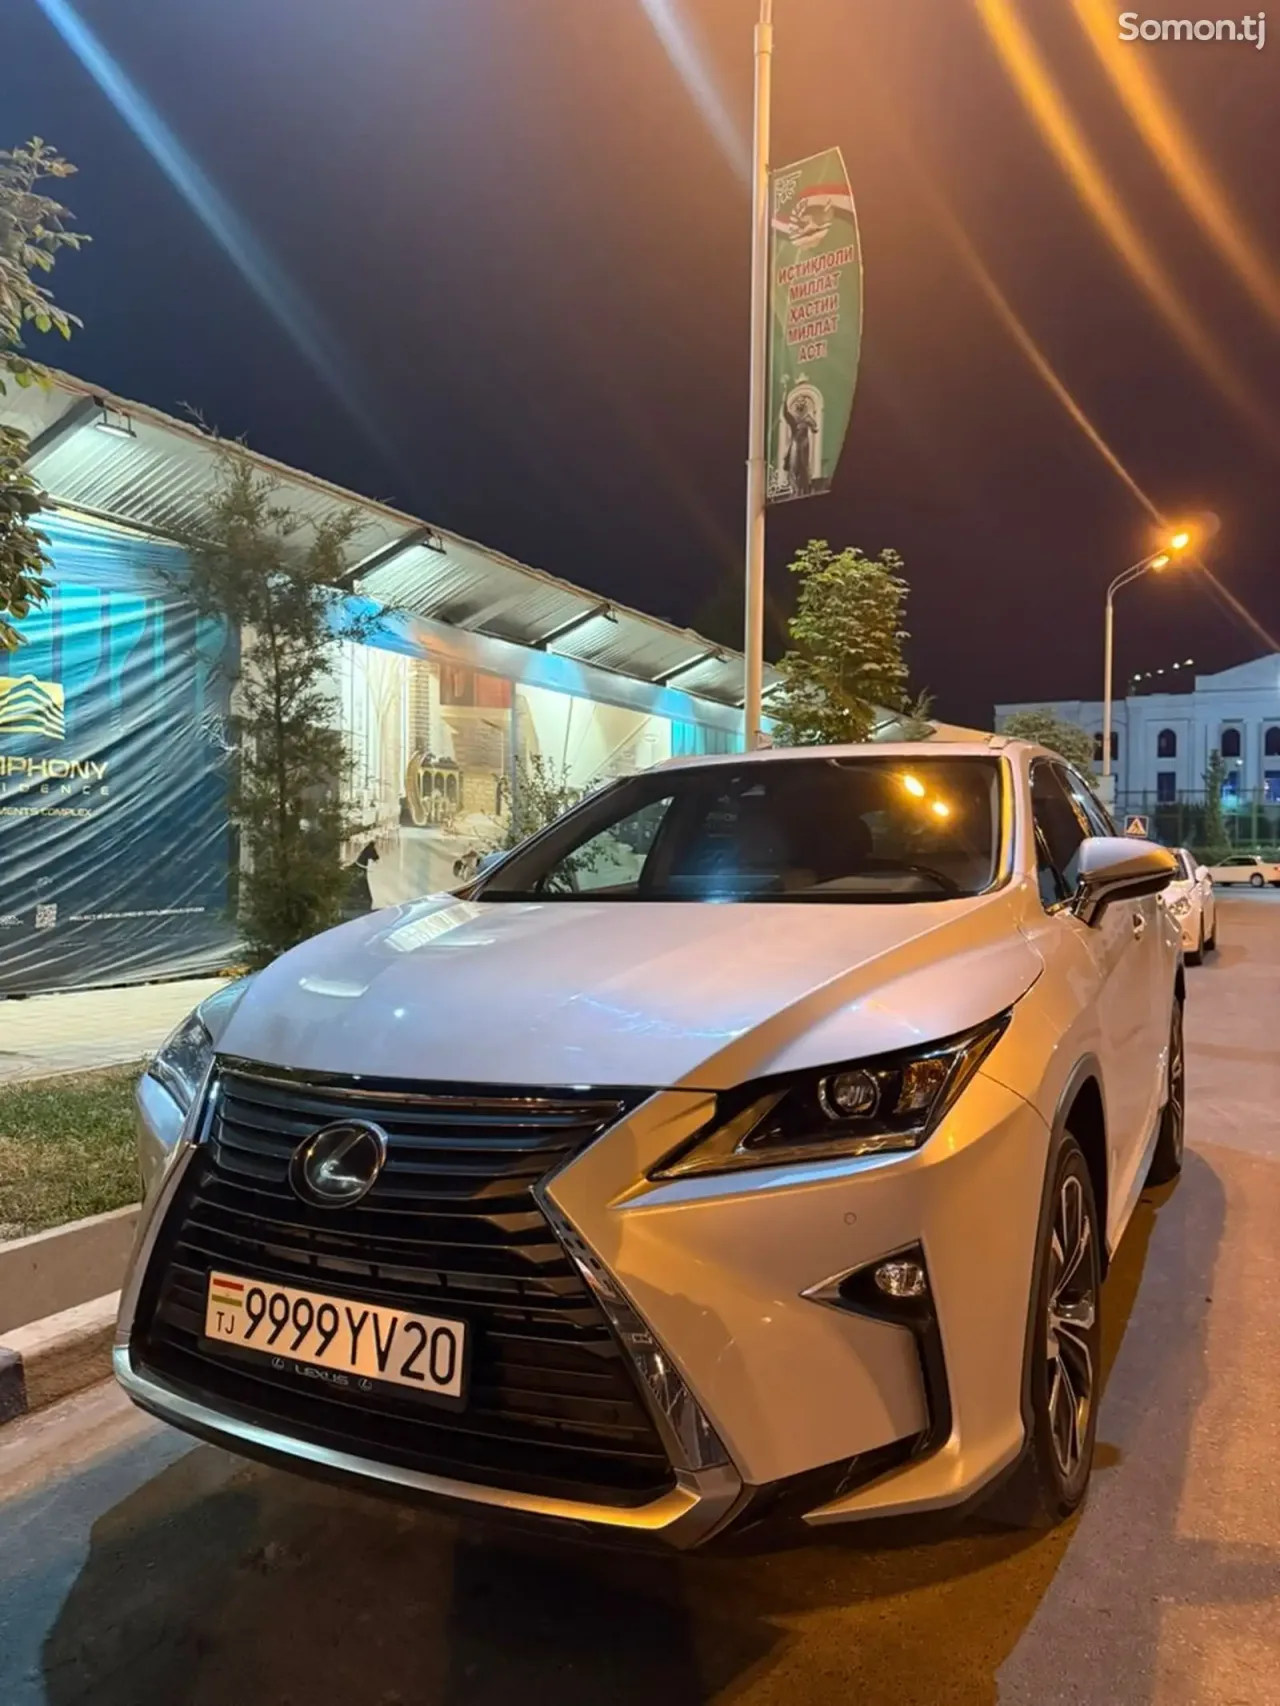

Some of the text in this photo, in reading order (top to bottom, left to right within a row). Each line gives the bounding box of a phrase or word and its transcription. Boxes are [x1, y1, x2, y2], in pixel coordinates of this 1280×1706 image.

[789, 271, 841, 301] МИЛЛАТ
[787, 316, 839, 343] МИЛЛАТ
[0, 756, 109, 780] PHONY
[216, 1286, 457, 1386] TJ 9999YV20
[294, 1363, 350, 1386] LEXUS
